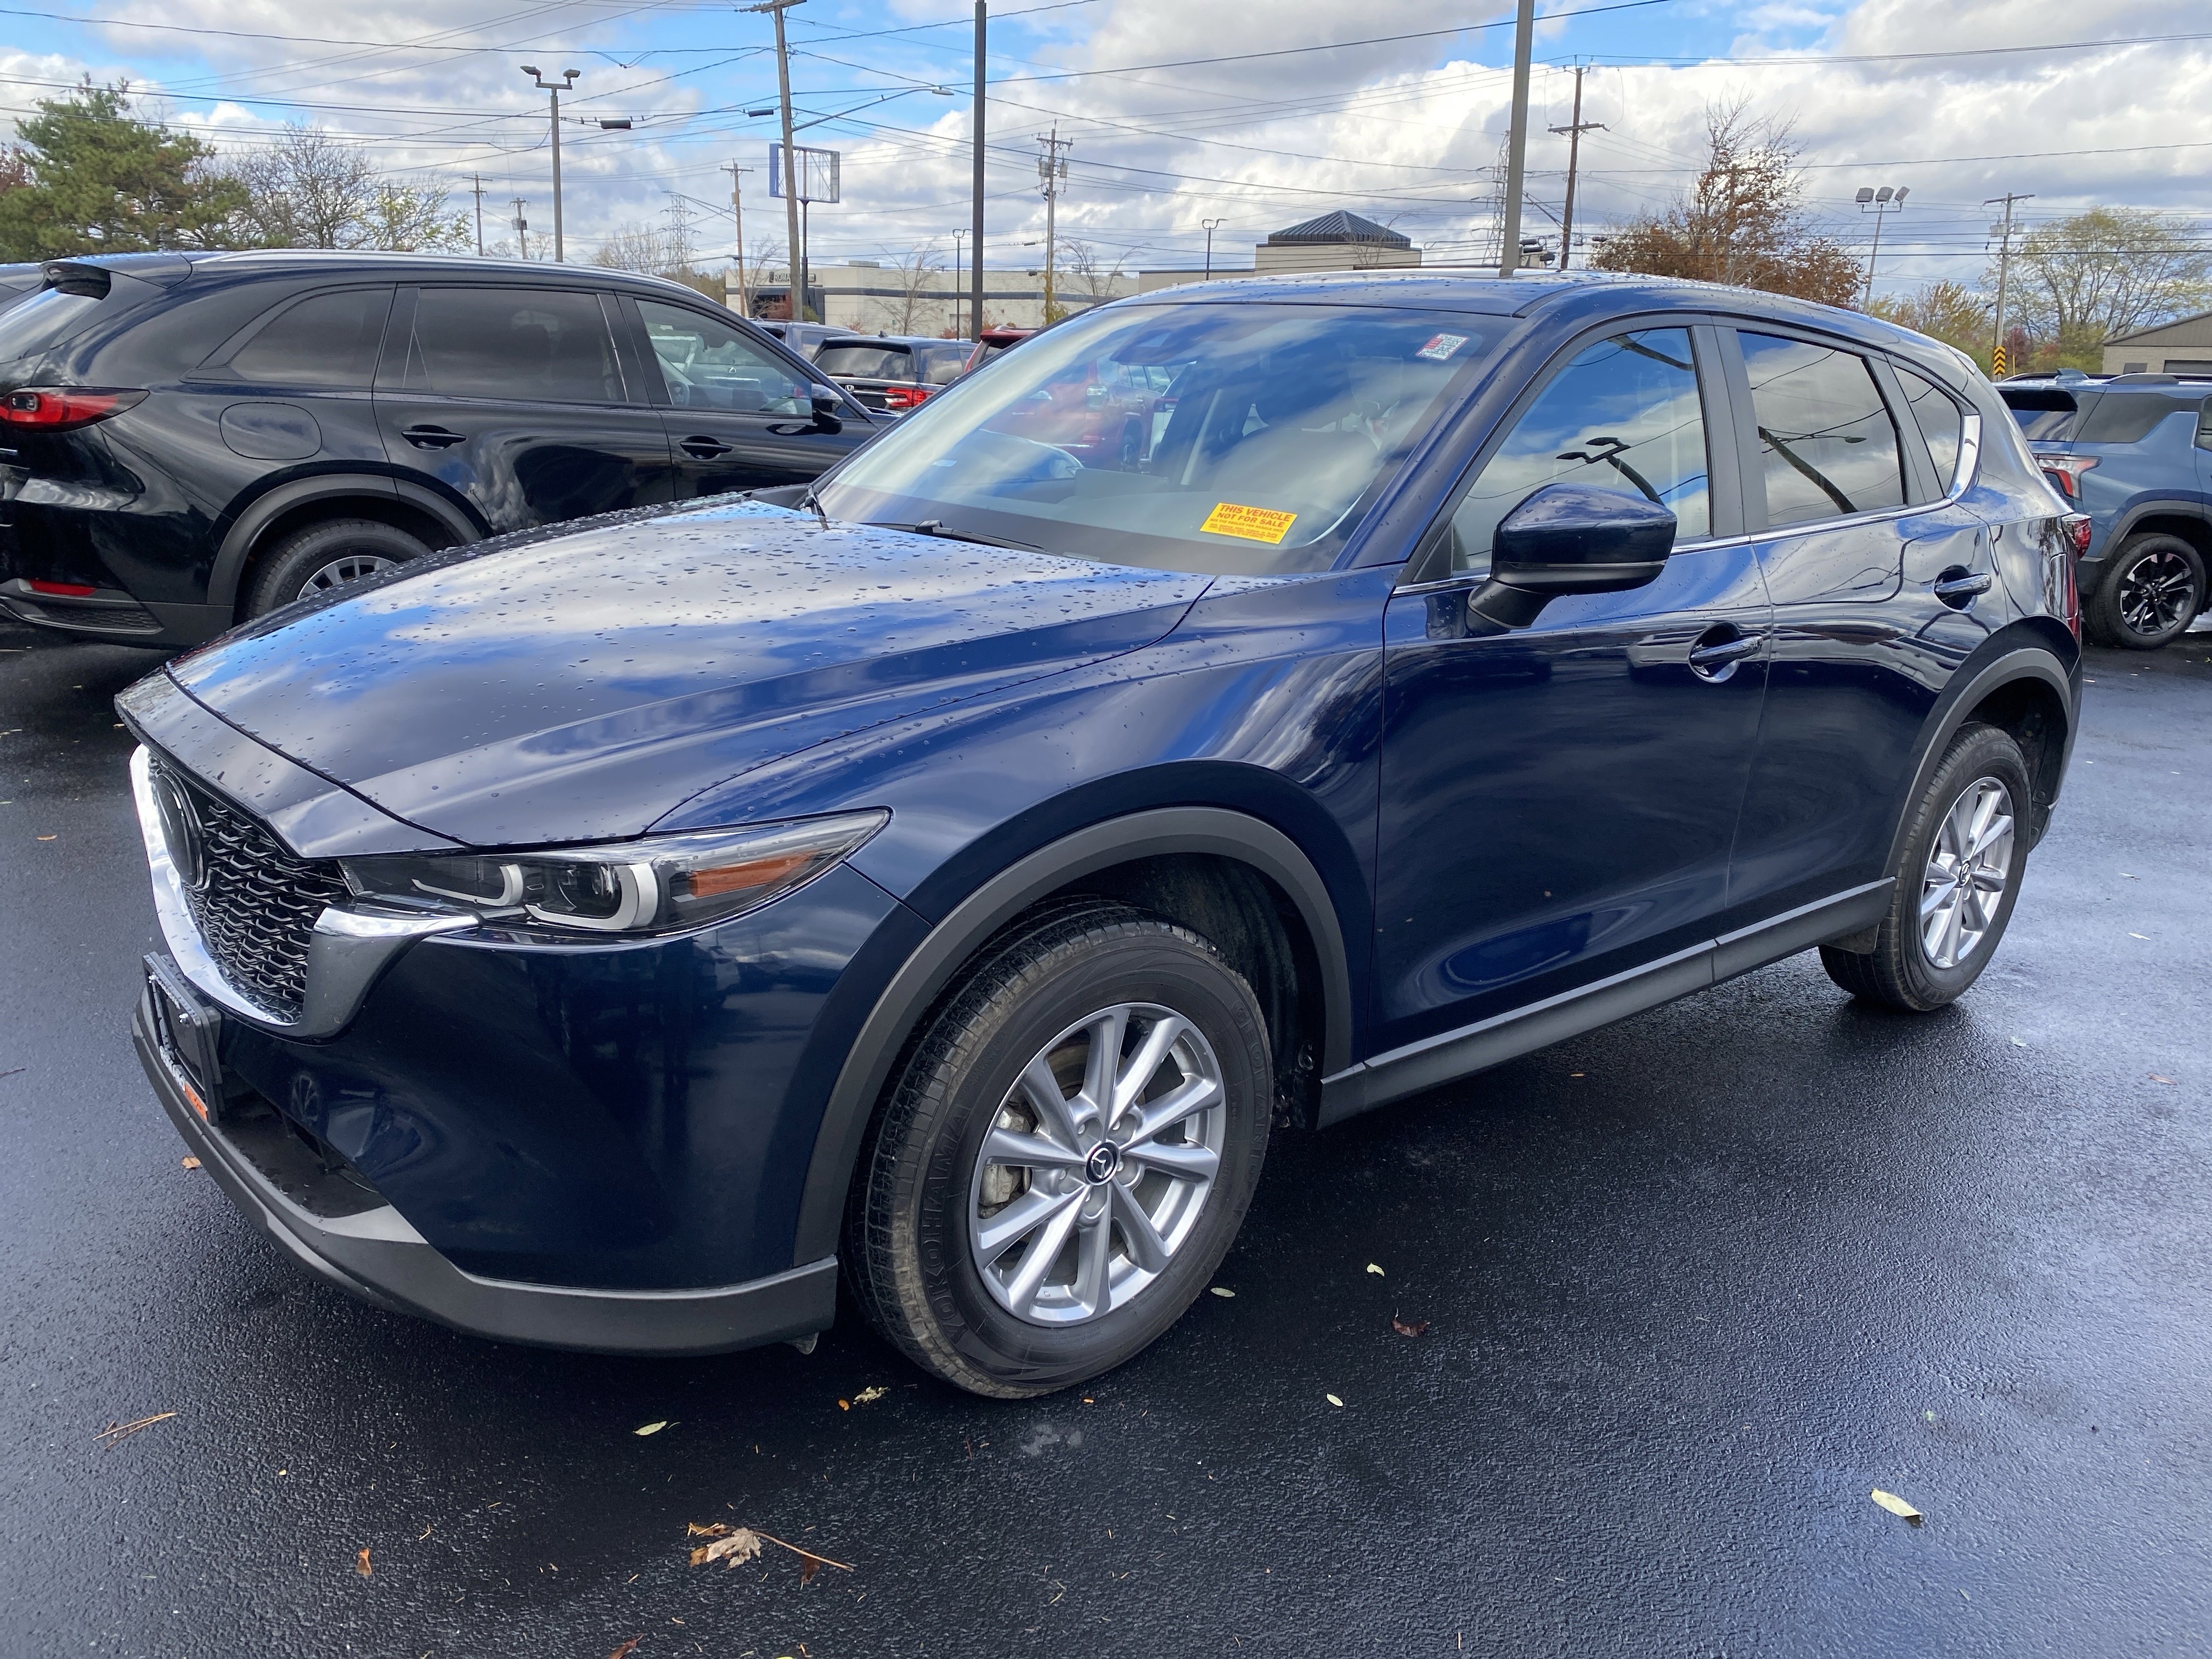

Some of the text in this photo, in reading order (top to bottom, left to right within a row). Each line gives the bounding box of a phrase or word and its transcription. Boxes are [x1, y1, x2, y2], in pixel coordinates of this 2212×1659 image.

[1220, 504, 1293, 522] THIS VEHICLE
[1238, 515, 1258, 523] FOR
[1259, 518, 1285, 528] SALE
[922, 1105, 969, 1344] YOKOHAMA
